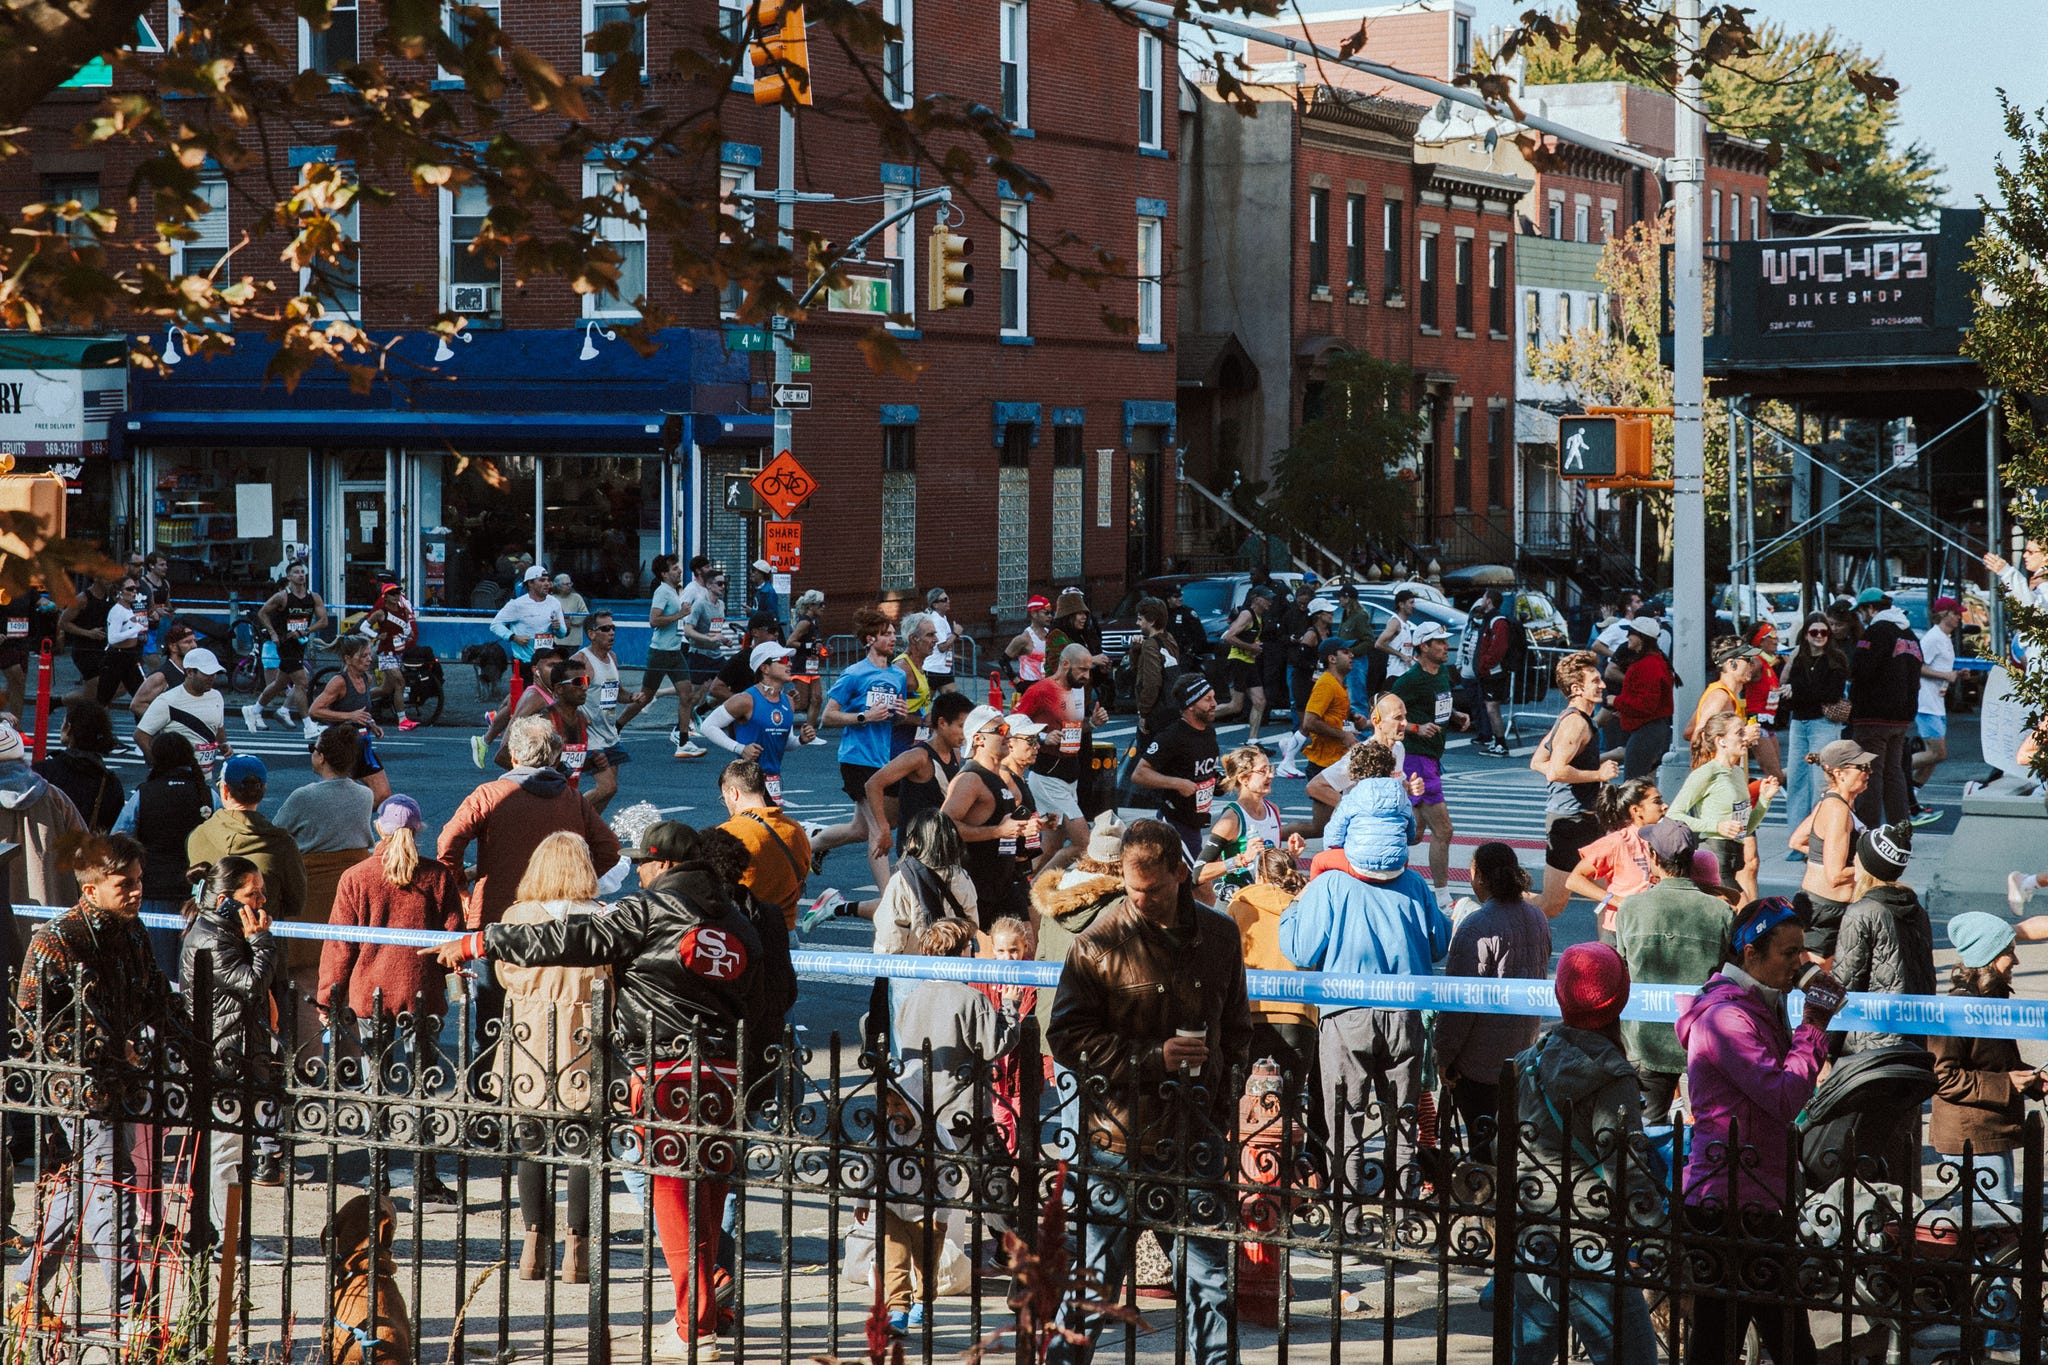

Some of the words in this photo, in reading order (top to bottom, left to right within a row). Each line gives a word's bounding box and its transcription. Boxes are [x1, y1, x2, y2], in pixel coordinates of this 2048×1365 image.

[1762, 242, 1928, 285] NACHOS
[850, 286, 861, 304] 14
[865, 286, 878, 307] St
[1788, 292, 1838, 306] BIKE
[1847, 289, 1902, 304] SHOP
[741, 333, 749, 348] 4
[752, 333, 761, 344] Av
[782, 391, 793, 401] ONE
[795, 391, 808, 401] WAY
[49, 422, 76, 430] DELIVERY
[2, 442, 26, 455] FRUITS
[768, 528, 799, 538] SHARE
[776, 542, 793, 553] THE
[1878, 841, 1901, 861] RUN
[696, 928, 740, 978] SF
[816, 955, 832, 973] DO
[847, 956, 872, 975] LINE
[876, 958, 918, 978] POLICE
[932, 961, 973, 980] CROSS
[977, 963, 1000, 981] NOT
[1003, 964, 1019, 982] DO
[1261, 975, 1305, 997] POLICE
[1321, 977, 1364, 999] CROSS
[1368, 979, 1394, 1001] NOT
[1398, 981, 1416, 1002] DO
[1432, 982, 1459, 1004] LINE
[1463, 982, 1510, 1006] POLICE
[1641, 989, 1672, 1012] LINE
[1860, 998, 1891, 1021] LINE
[1896, 1001, 1944, 1024] POLICE
[1963, 1003, 2012, 1027] CROSS
[2016, 1005, 2046, 1028] NOT
